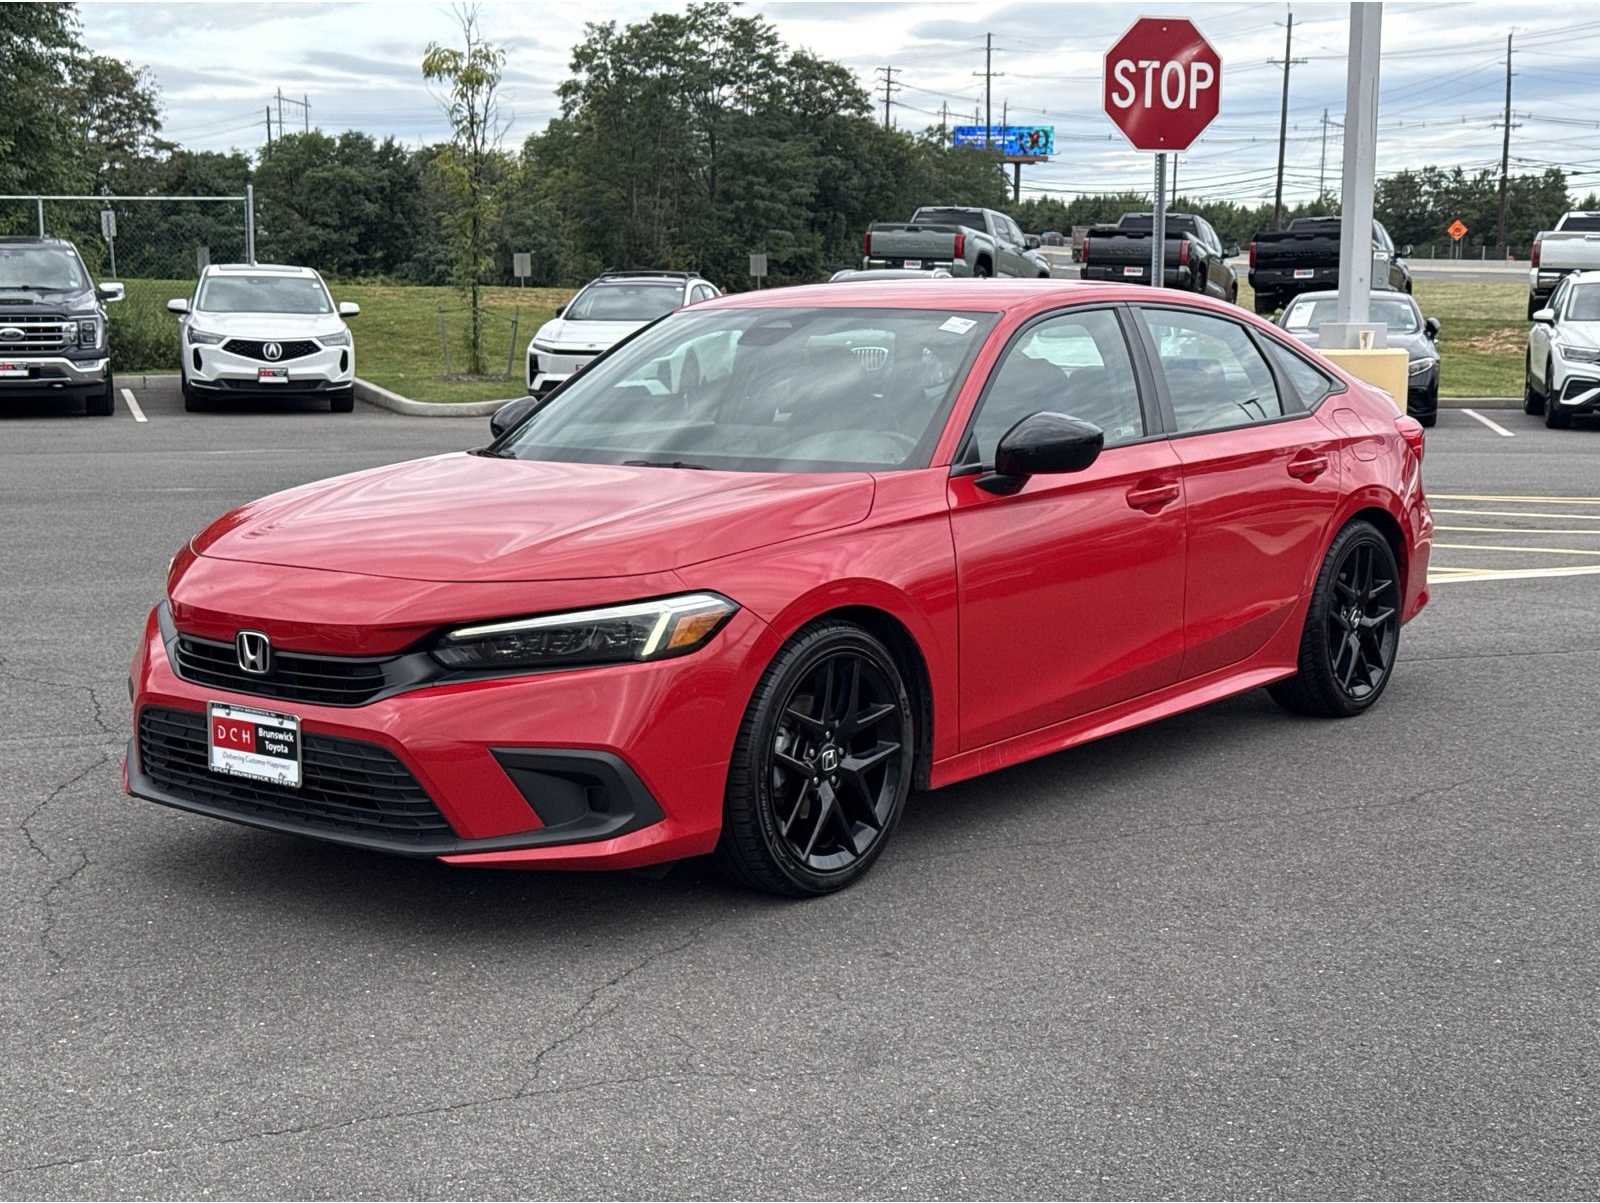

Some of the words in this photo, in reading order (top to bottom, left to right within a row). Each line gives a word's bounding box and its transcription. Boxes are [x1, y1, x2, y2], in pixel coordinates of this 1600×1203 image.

[1111, 59, 1214, 109] STOP
[258, 727, 294, 743] Brunswick
[265, 740, 289, 754] Toyota
